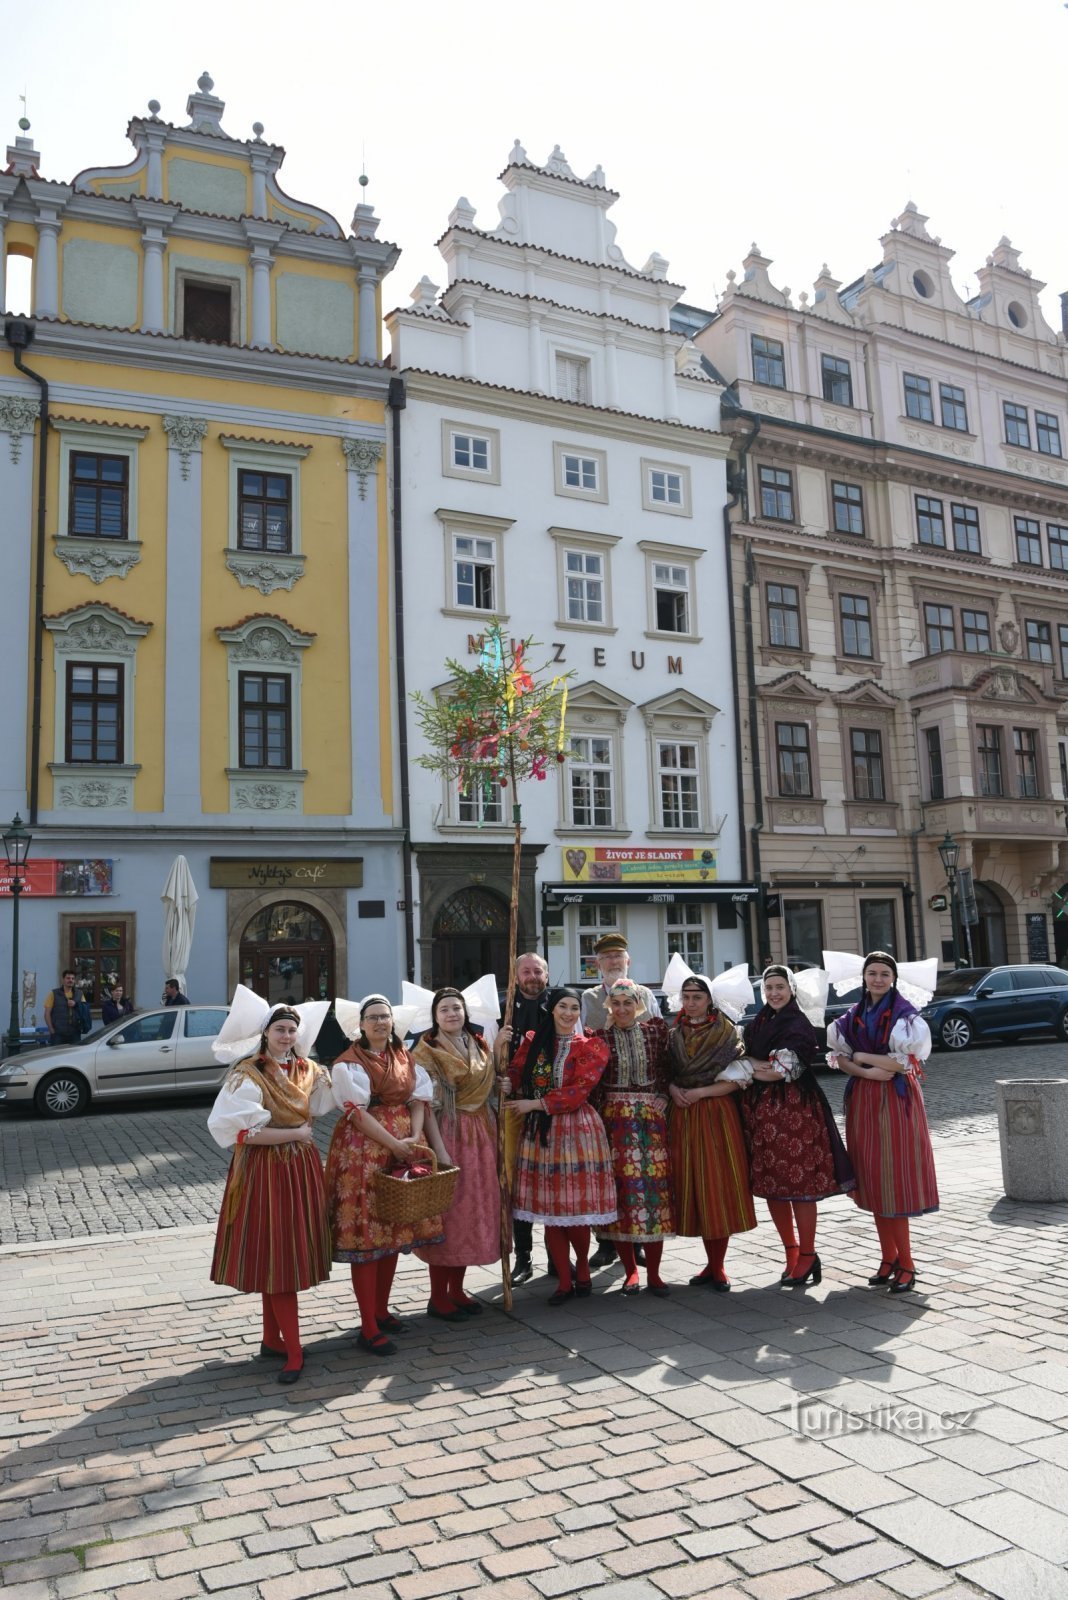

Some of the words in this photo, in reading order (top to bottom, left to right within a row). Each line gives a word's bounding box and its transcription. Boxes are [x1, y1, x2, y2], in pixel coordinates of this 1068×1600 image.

[467, 634, 684, 675] MUZEUM
[606, 850, 633, 860] ŽIVOT
[635, 852, 645, 860] JE
[647, 850, 684, 860] SLADKÝ
[652, 894, 675, 904] BISTRO
